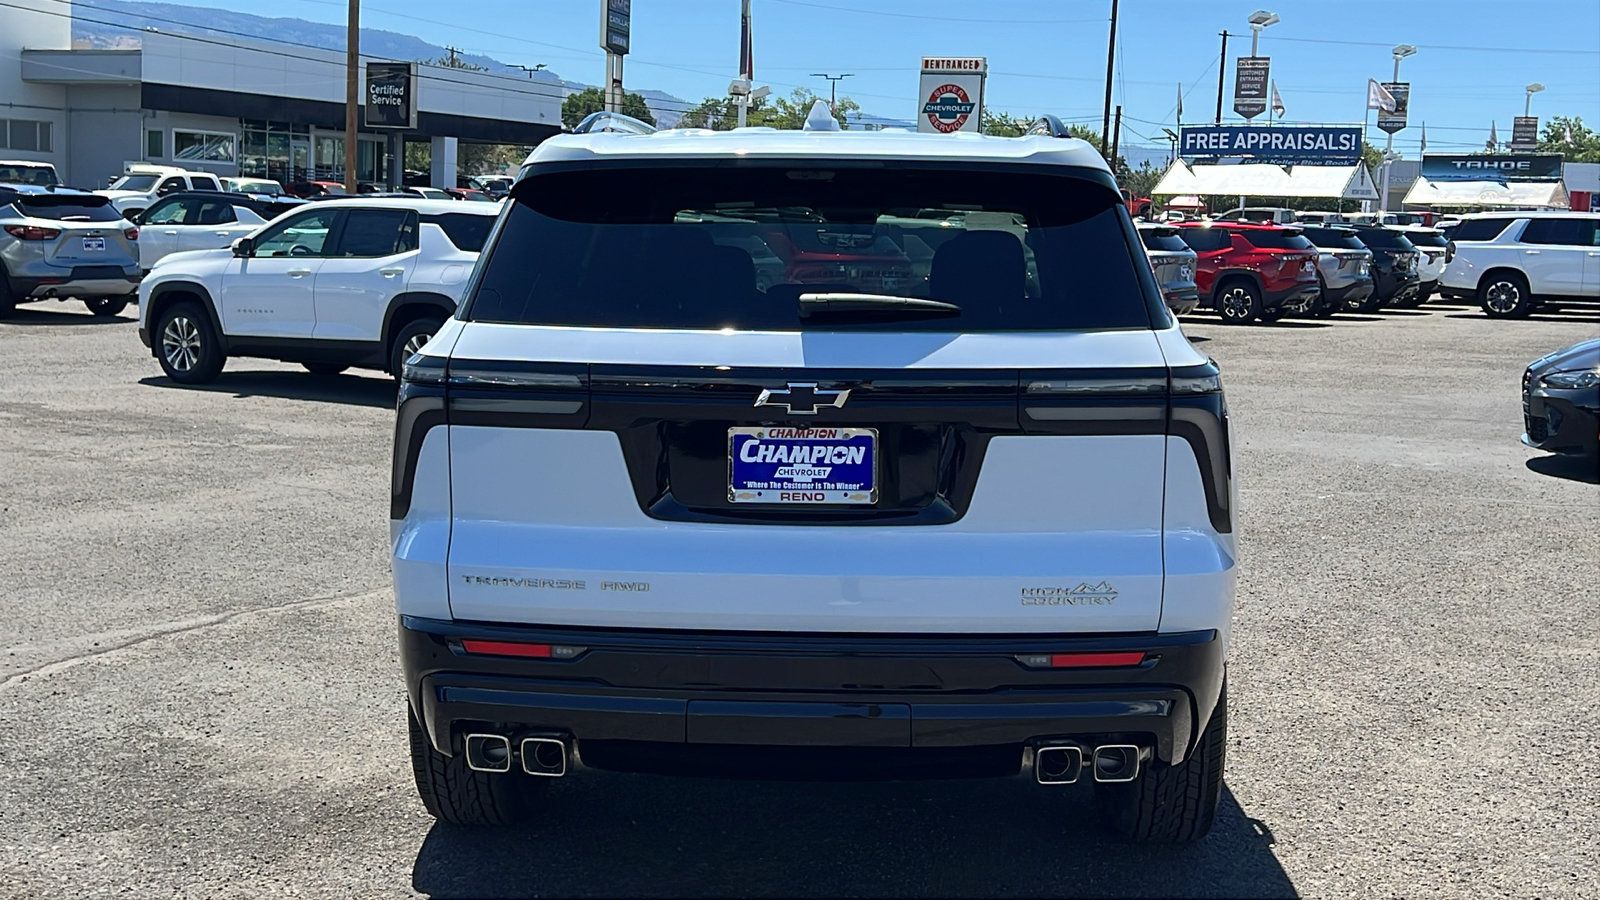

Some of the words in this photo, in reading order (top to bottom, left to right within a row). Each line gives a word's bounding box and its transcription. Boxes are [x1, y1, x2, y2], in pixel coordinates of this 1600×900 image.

[930, 59, 973, 70] ENTRANCE
[370, 84, 404, 96] Certified
[934, 85, 965, 98] SUPER
[371, 94, 402, 106] Service
[925, 104, 971, 112] CHEVROLET
[930, 116, 965, 132] SERVICE
[1185, 132, 1230, 150] FREE
[1233, 133, 1356, 151] APPRAISALS!
[1451, 160, 1531, 171] TAHOE
[768, 428, 838, 439] CHAMPION
[739, 439, 866, 465] CHAMPION
[778, 468, 828, 477] CHEVROLET
[769, 481, 782, 489] The
[783, 481, 814, 490] Customer
[815, 482, 822, 490] Is
[823, 482, 836, 490] The
[780, 492, 826, 502] RENO
[462, 574, 587, 590] TRAVERSE
[600, 580, 650, 592] AWD
[1021, 587, 1071, 596] HIGH
[1021, 596, 1118, 606] COUNTRY
